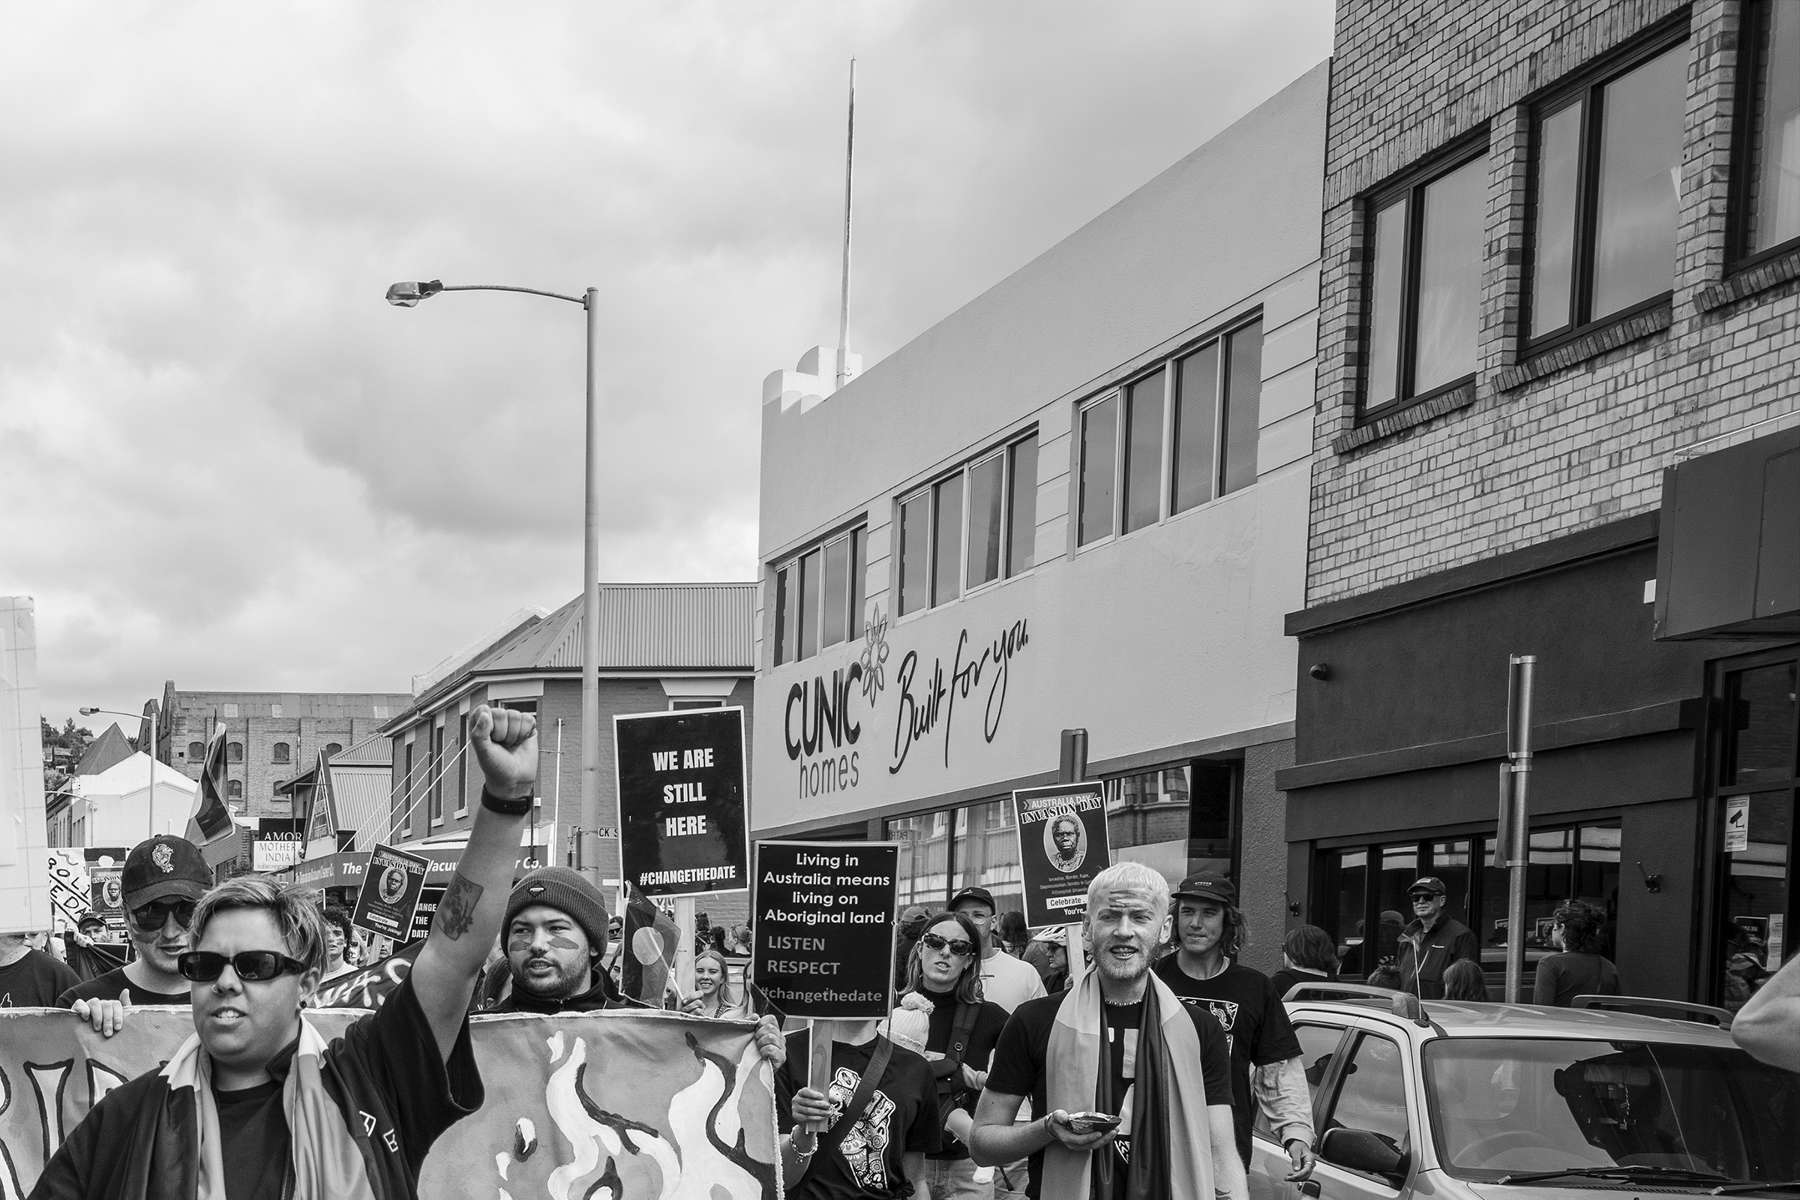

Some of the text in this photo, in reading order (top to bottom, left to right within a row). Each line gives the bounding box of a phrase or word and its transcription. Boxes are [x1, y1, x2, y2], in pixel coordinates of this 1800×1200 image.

[889, 650, 946, 775] Built
[944, 629, 990, 768] for
[785, 662, 862, 761] CUNIC
[653, 748, 714, 771] WE ARE
[799, 751, 859, 799] homes
[663, 783, 706, 803] STILL
[1021, 797, 1102, 824] INVASION DAY
[666, 815, 707, 837] HERE
[265, 853, 291, 861] INDIA
[796, 853, 858, 869] Living in
[342, 862, 362, 874] The
[639, 865, 736, 885] #CHANGETHEDATE
[763, 872, 890, 886] Australia means
[792, 892, 858, 907] living on
[1051, 898, 1081, 906] Celebrate
[416, 917, 428, 925] THE
[765, 910, 884, 926] Aboriginal land
[768, 936, 825, 951] LISTEN
[768, 960, 840, 975] RESPECT
[761, 987, 882, 1003] #changethedate
